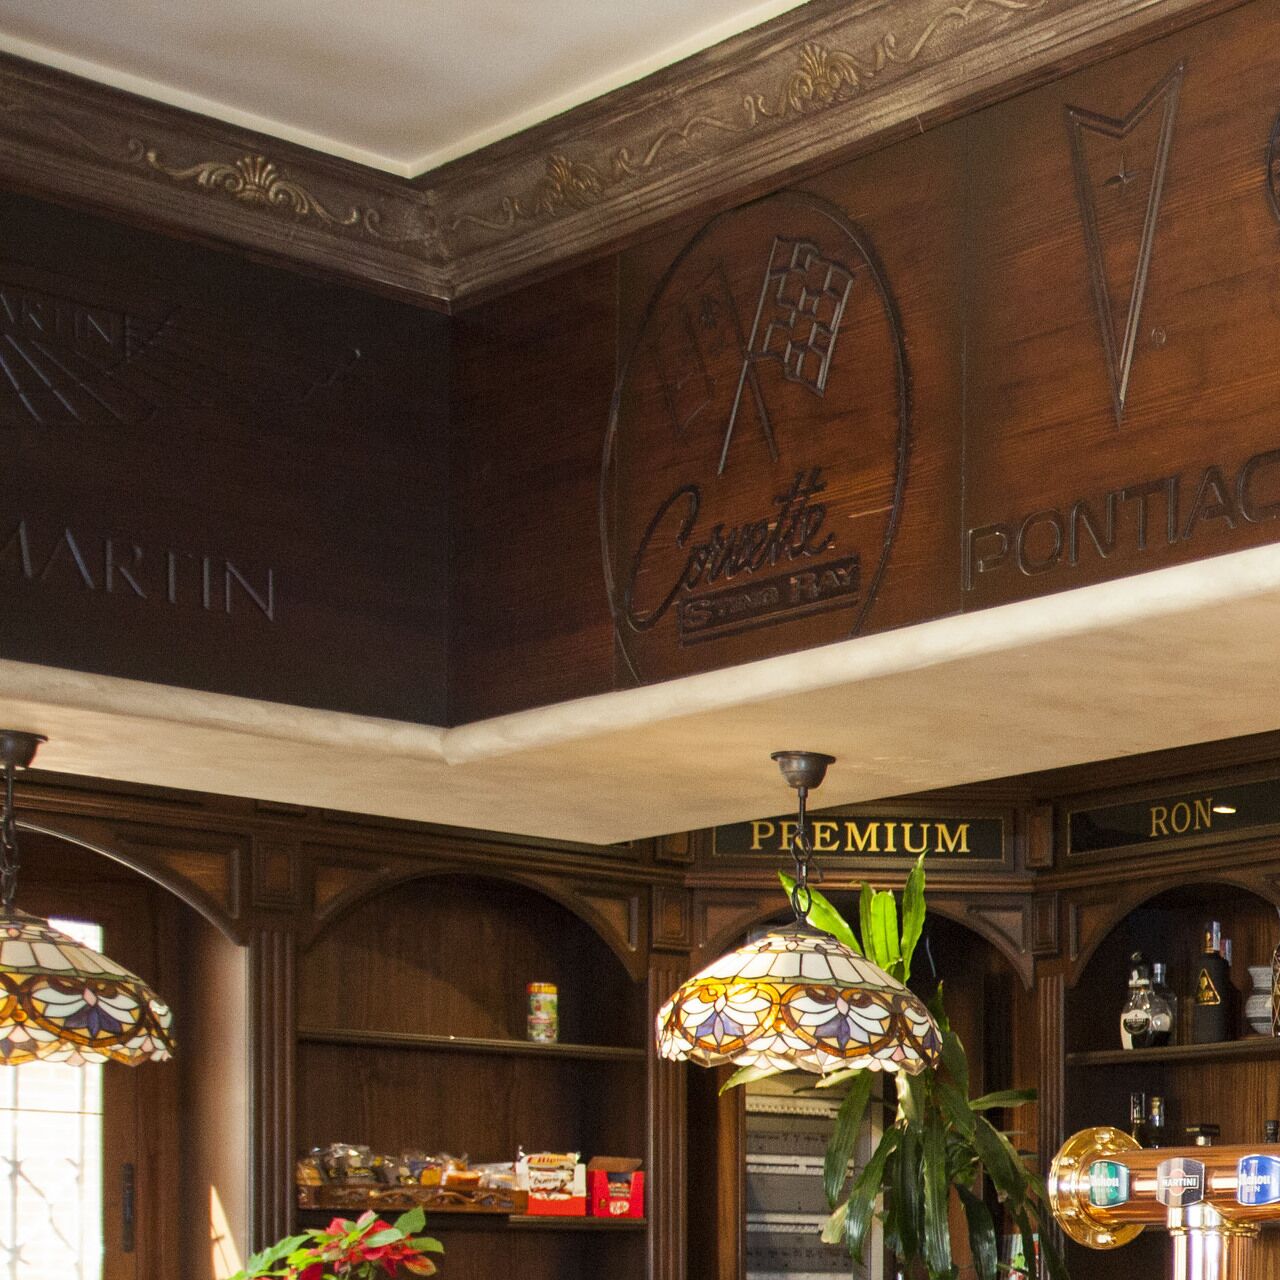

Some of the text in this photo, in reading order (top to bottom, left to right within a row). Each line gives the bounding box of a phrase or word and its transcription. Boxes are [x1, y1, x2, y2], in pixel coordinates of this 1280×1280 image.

[624, 464, 837, 633] Corvette
[1150, 797, 1213, 837] RON
[750, 821, 971, 853] PREMIUM
[1161, 1177, 1197, 1188] MARTINI
